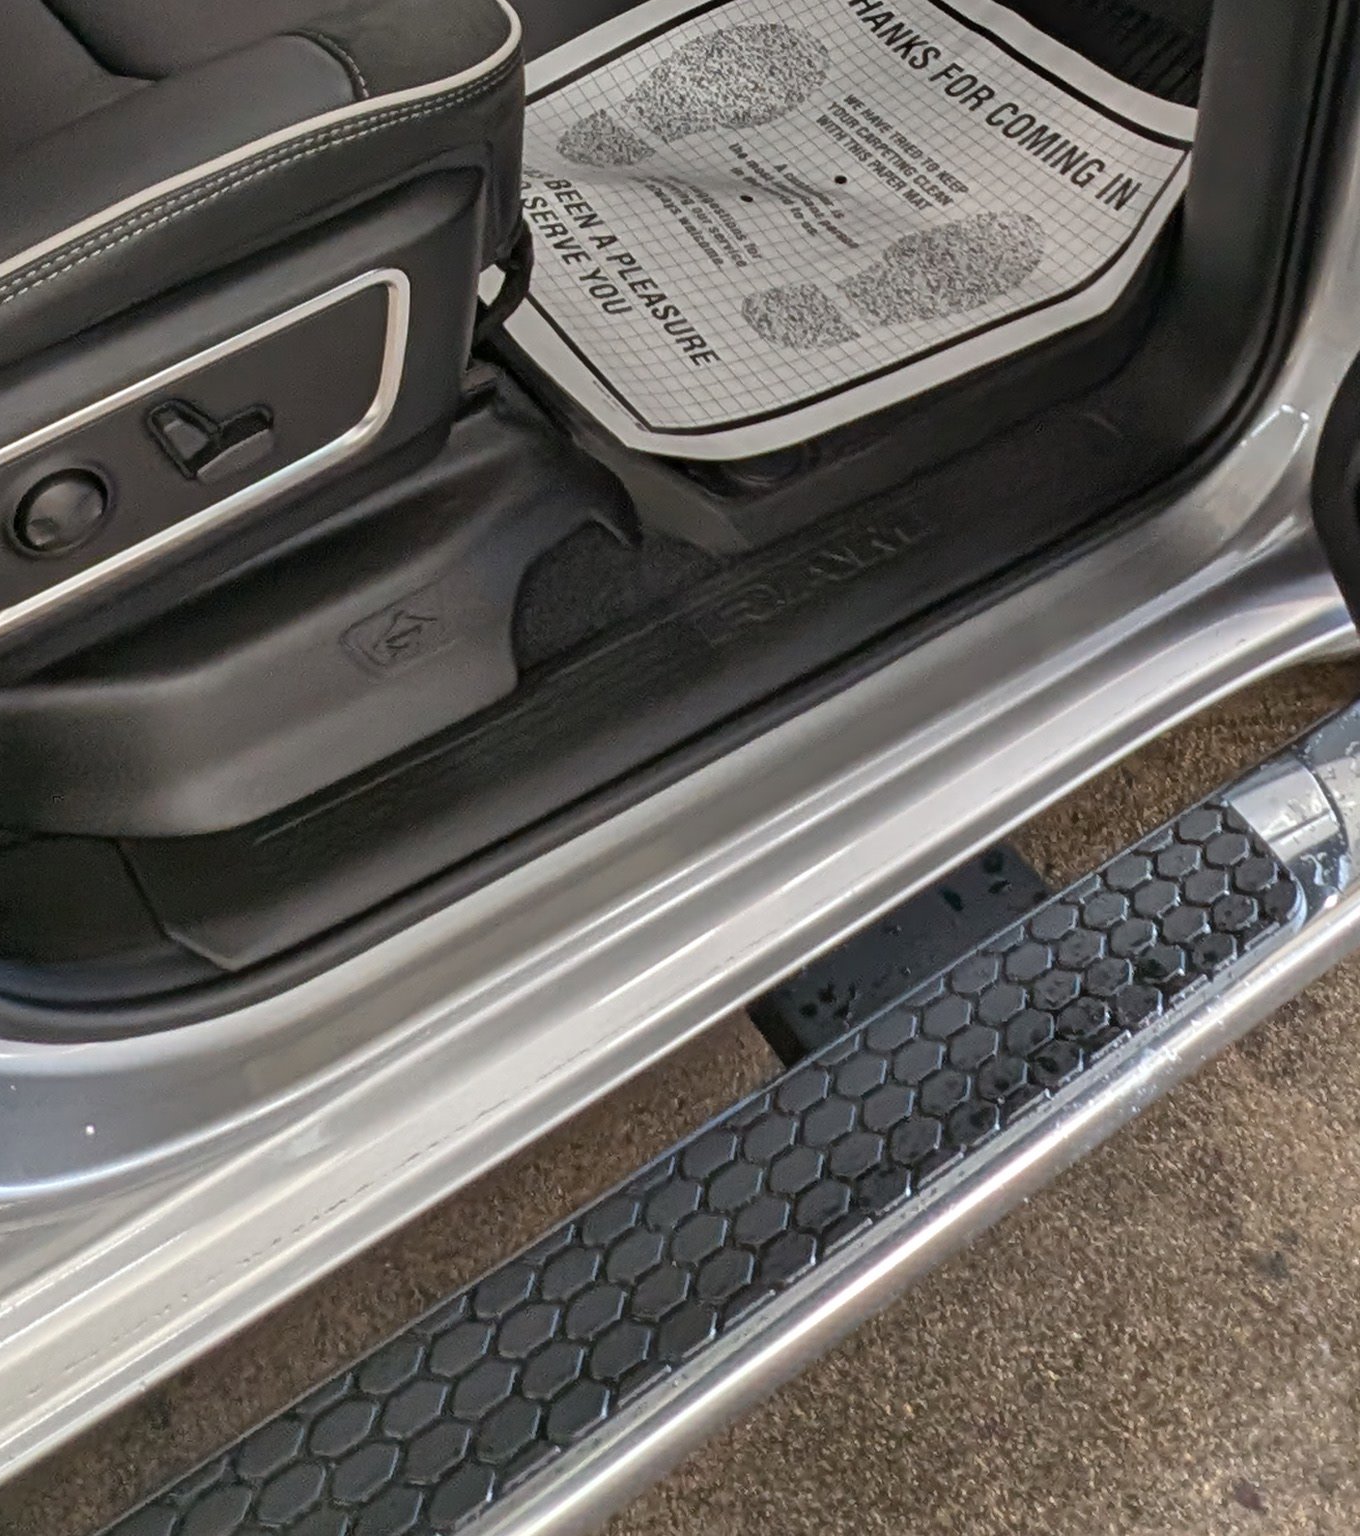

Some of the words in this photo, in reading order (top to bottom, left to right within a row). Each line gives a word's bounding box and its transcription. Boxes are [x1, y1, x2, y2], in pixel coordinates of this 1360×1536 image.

[816, 115, 849, 142] WITH
[844, 136, 873, 162] THIS
[868, 159, 907, 192] PAPER
[902, 189, 933, 210] MAT
[828, 102, 860, 129] YOUR
[856, 126, 917, 177] CARPETING
[913, 175, 954, 206] CLEAN
[844, 94, 864, 111] WE
[861, 108, 893, 134] HAVE
[890, 131, 923, 160] TRIED
[921, 157, 940, 173] TO
[936, 171, 969, 194] KEEP
[929, 63, 995, 112] FOR
[986, 102, 1106, 189] COMING
[1095, 173, 1142, 211] IN
[520, 196, 592, 265] SERVE
[579, 267, 633, 315] YOU
[544, 179, 604, 229] BEEN
[589, 235, 619, 249] A
[606, 252, 721, 366] PLEASURE
[678, 216, 724, 265] welcome
[691, 207, 713, 224] our
[708, 226, 748, 267] service
[743, 243, 763, 259] for
